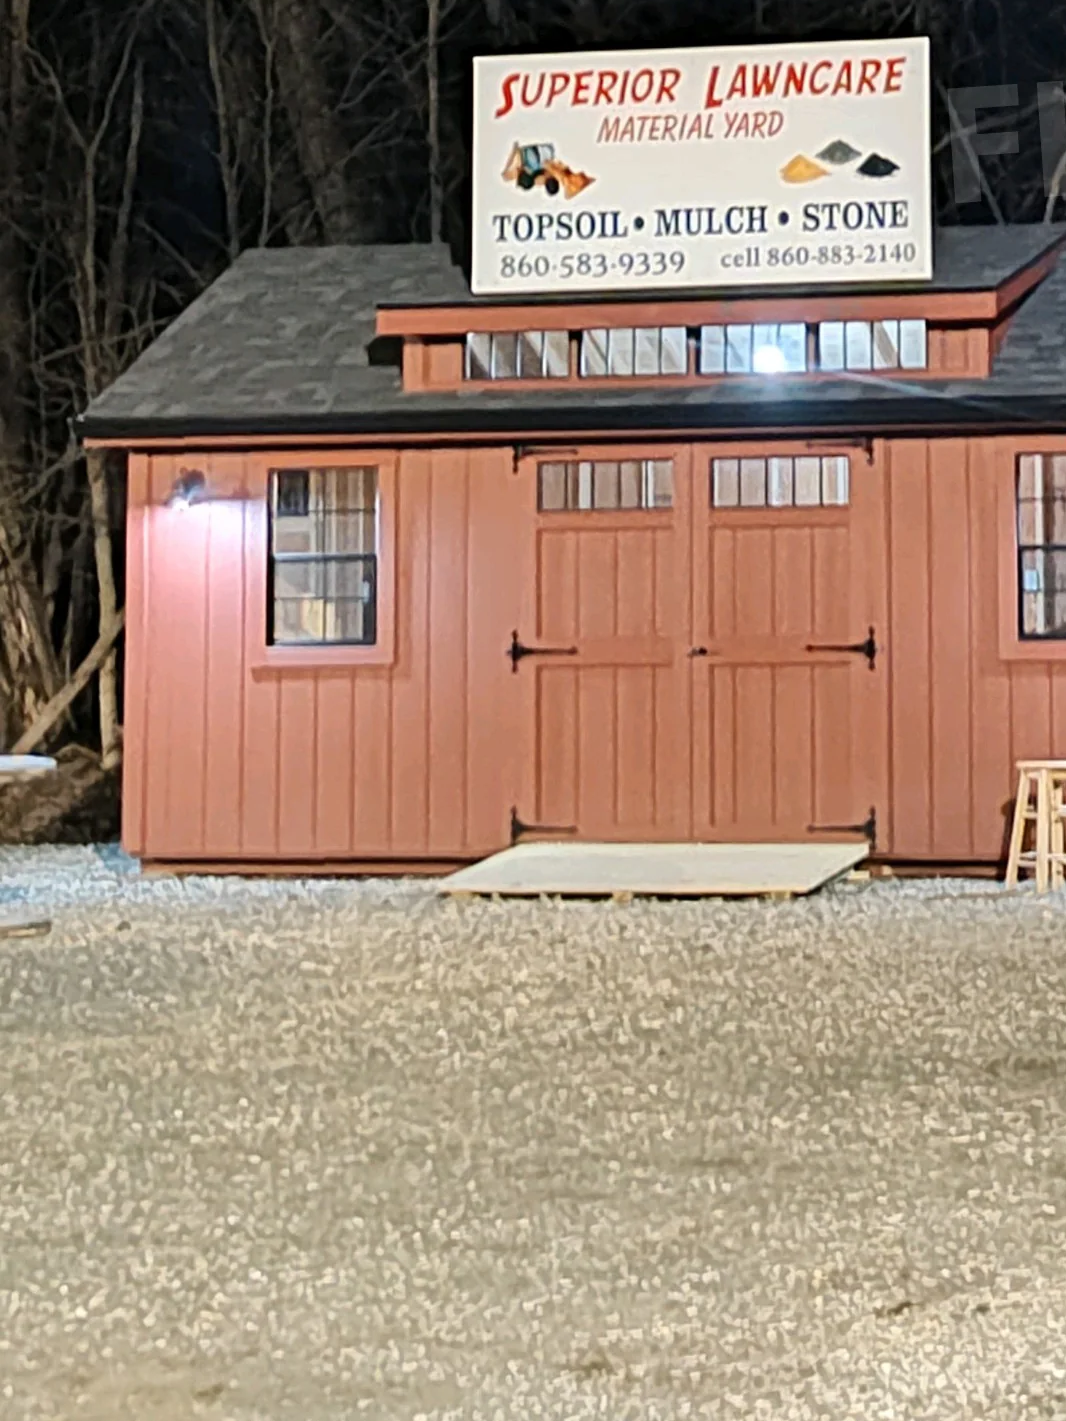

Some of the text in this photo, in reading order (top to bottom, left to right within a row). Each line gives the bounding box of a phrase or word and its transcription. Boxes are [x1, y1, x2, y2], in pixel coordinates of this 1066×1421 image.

[495, 57, 906, 119] SUPERIOR LAWNCARE
[596, 111, 785, 143] MATERIAL YARD
[493, 201, 909, 242] TOPSOIL MULCH STONE
[720, 246, 760, 268] cell
[767, 243, 916, 267] 860-883-2140
